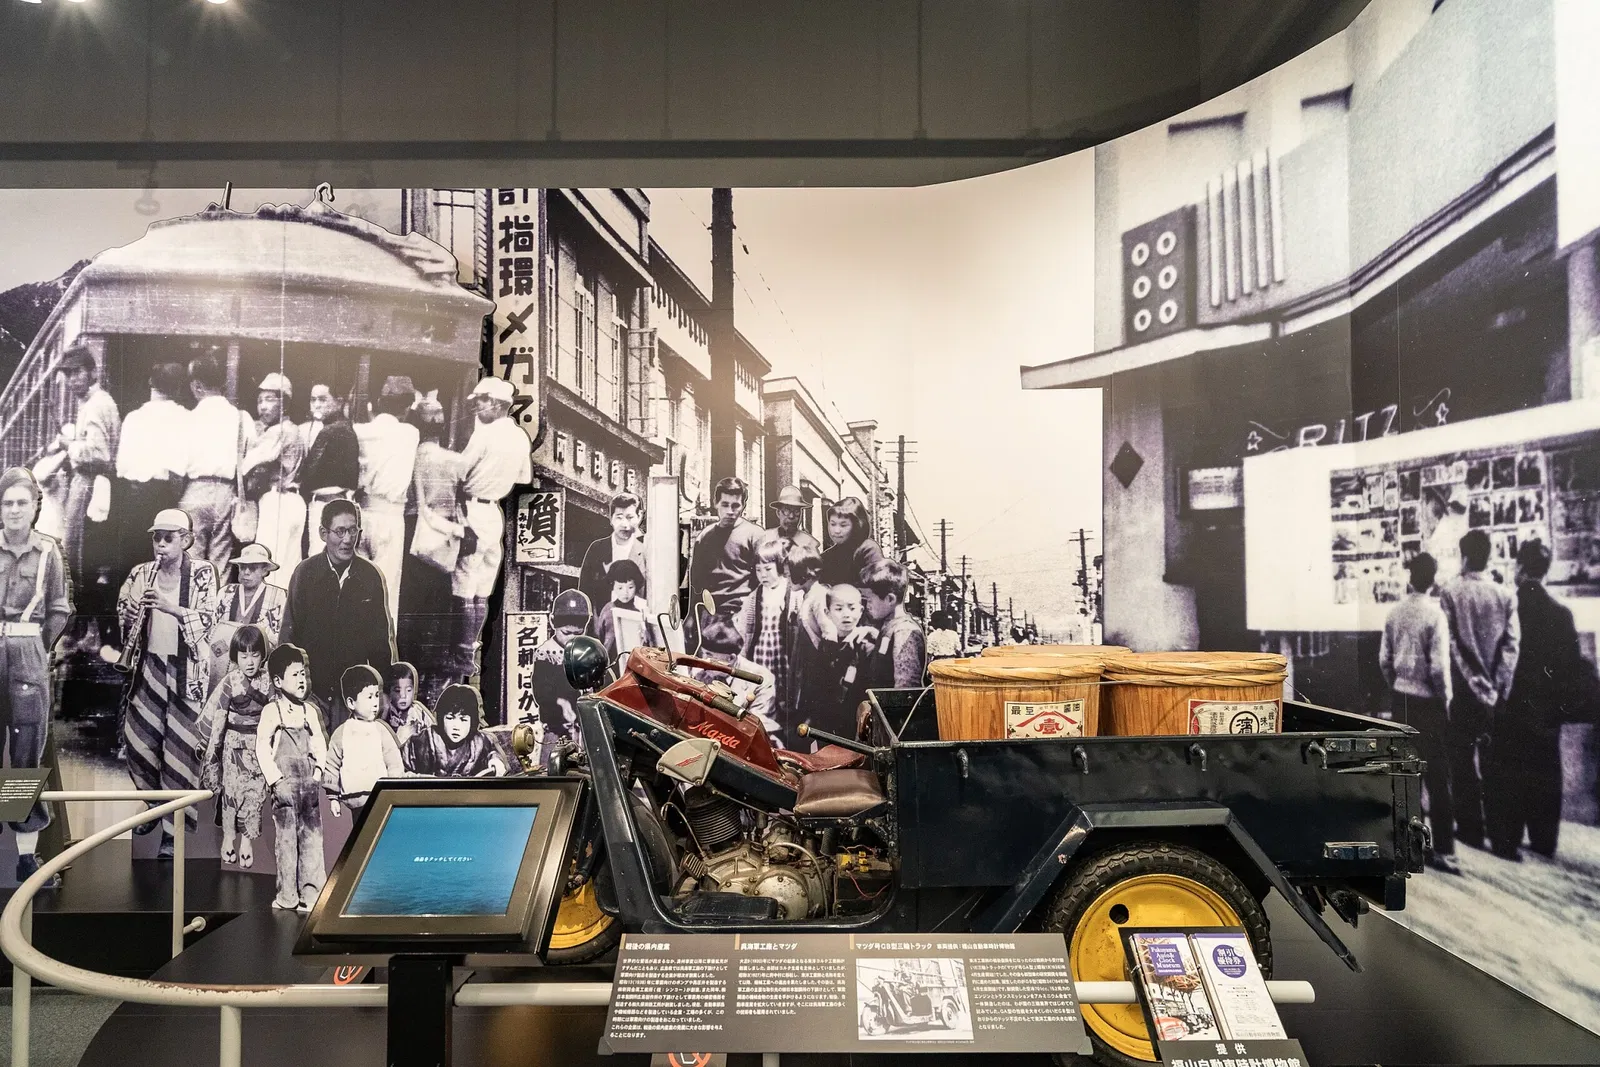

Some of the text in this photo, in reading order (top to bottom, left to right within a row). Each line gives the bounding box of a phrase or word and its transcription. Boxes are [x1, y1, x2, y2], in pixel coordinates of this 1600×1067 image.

[1299, 405, 1399, 447] RITZ
[526, 493, 560, 546] 質
[688, 721, 740, 749] Mazda
[1215, 1043, 1247, 1055] 提供
